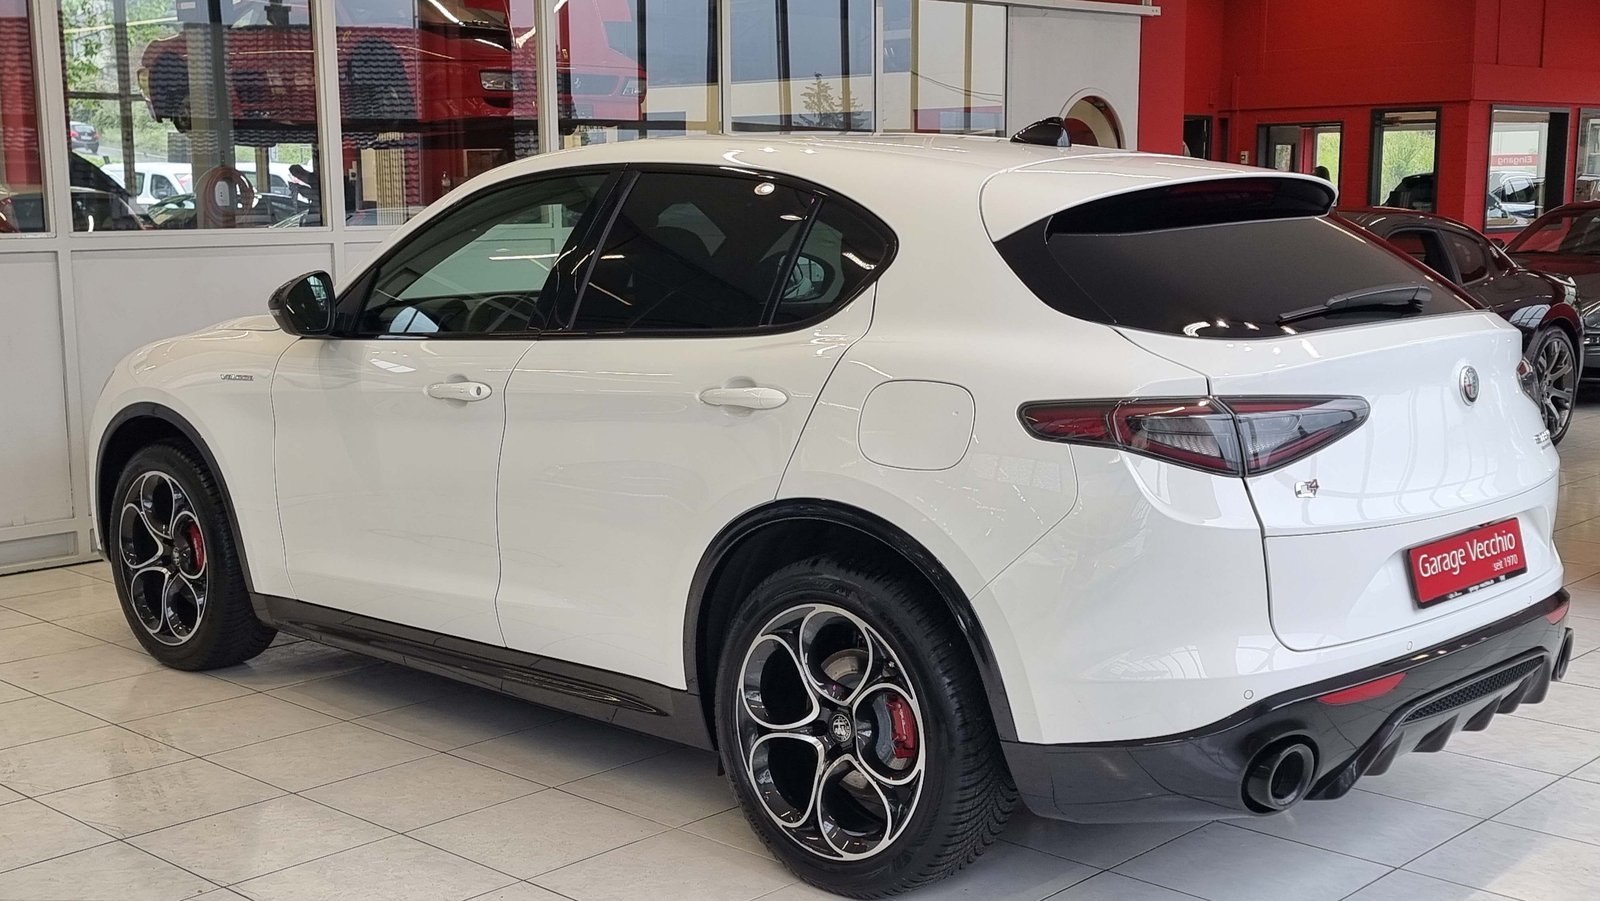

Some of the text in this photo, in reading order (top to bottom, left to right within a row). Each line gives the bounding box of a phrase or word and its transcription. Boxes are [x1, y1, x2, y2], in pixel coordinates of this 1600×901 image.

[1418, 530, 1516, 578] Garage Vecchio
[1493, 553, 1519, 571] seit 1970
